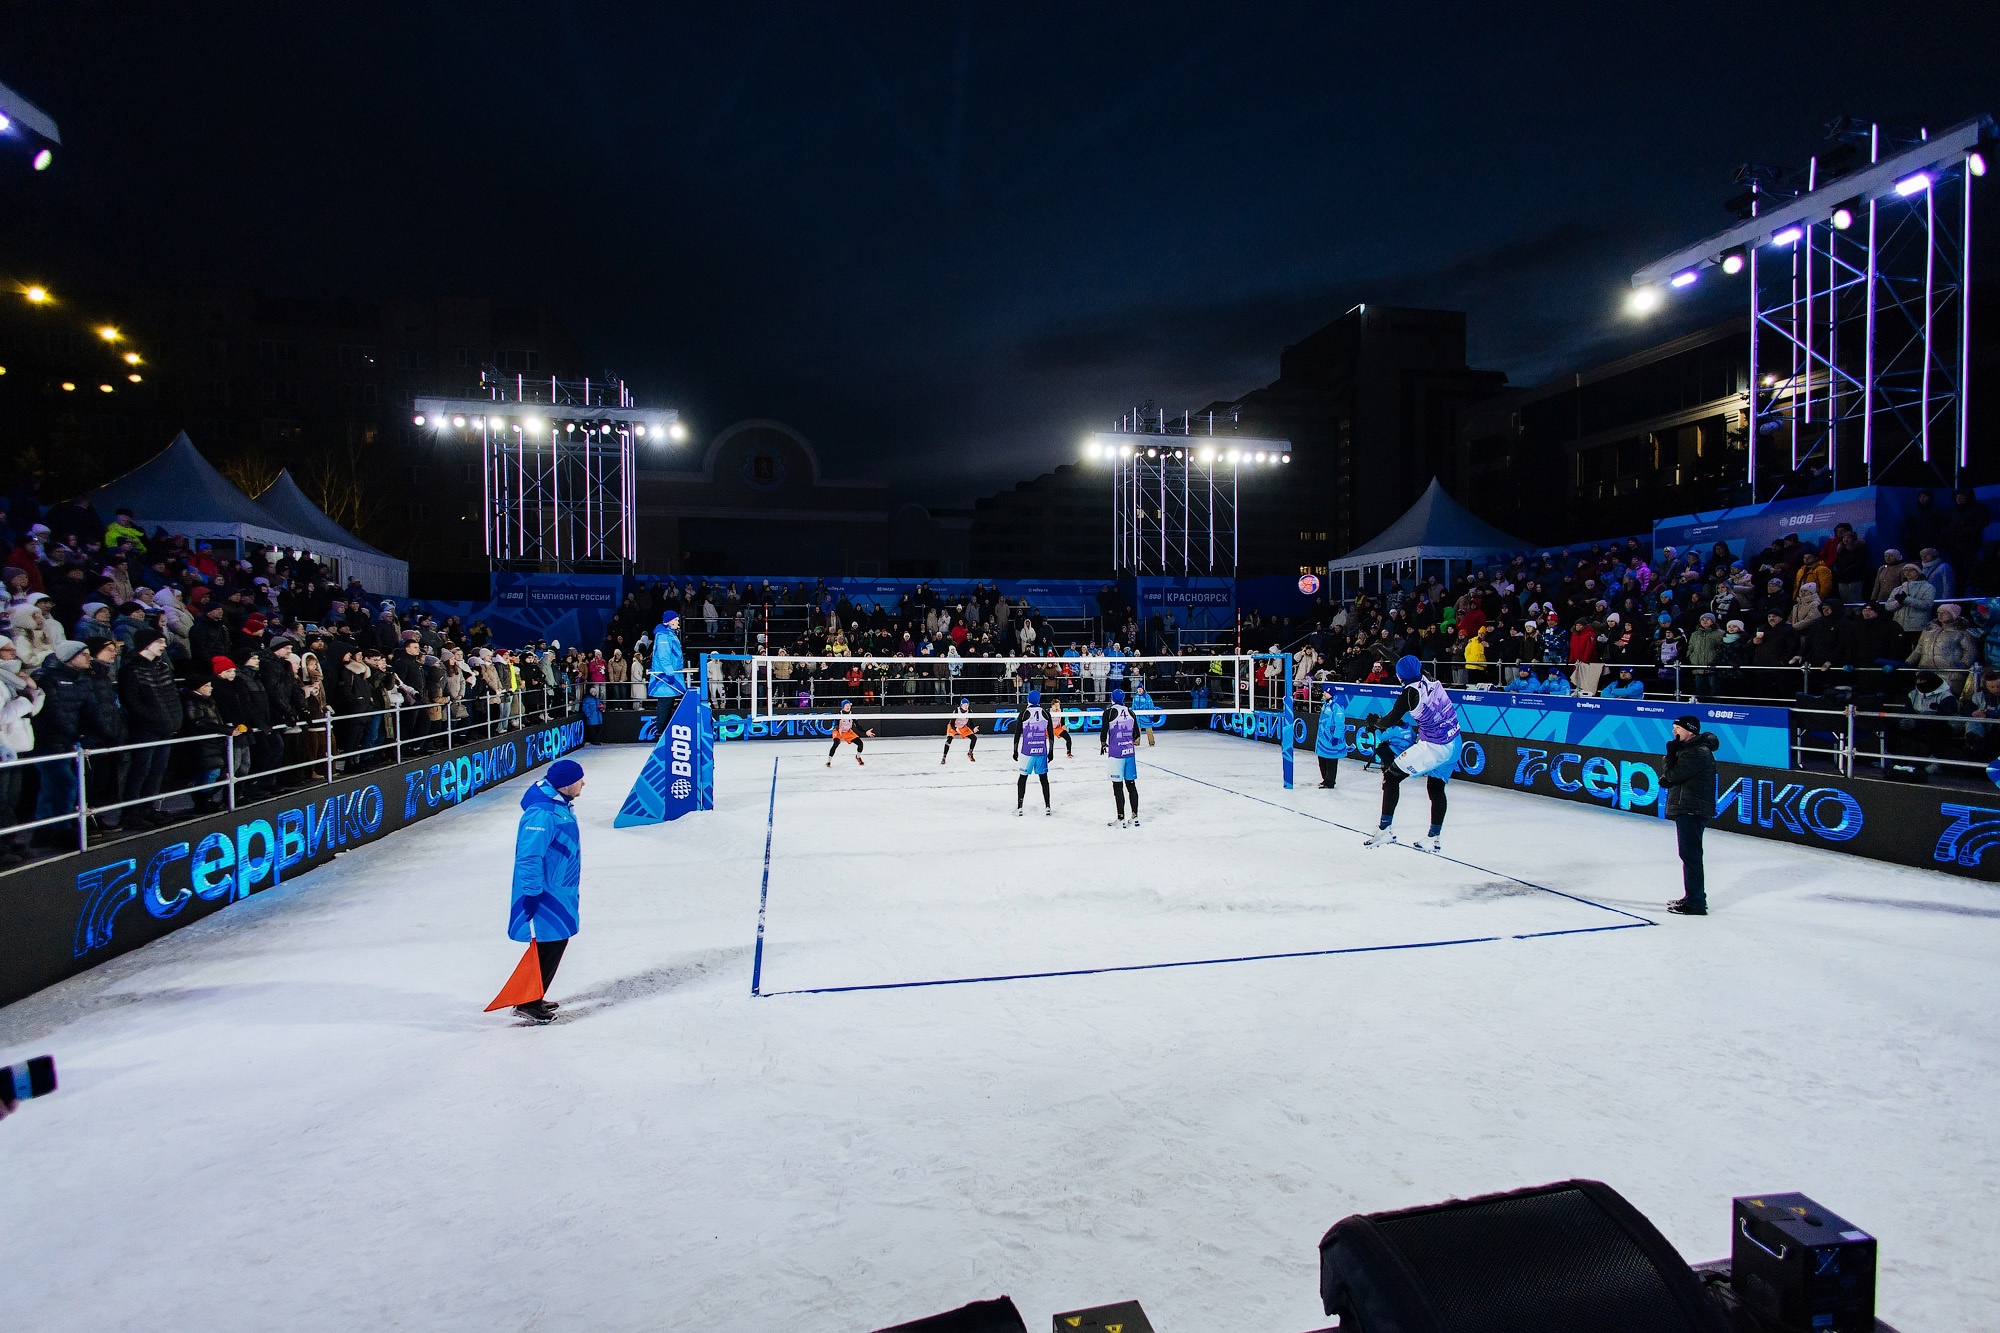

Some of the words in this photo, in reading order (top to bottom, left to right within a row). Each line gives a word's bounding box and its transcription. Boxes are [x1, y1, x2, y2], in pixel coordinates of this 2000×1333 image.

[1788, 513, 1814, 526] ВФВ
[531, 593, 579, 601] ЧЕМПИОНАТ
[580, 593, 611, 602] РОССИИ
[1167, 592, 1228, 602] КРАСНОЯРСК
[1221, 710, 1308, 744] сервио
[1715, 710, 1734, 719] ВФВ
[671, 724, 692, 777] ВФВ
[425, 741, 517, 808] сервико
[1549, 752, 1865, 842] серико
[141, 783, 385, 920] сервико
